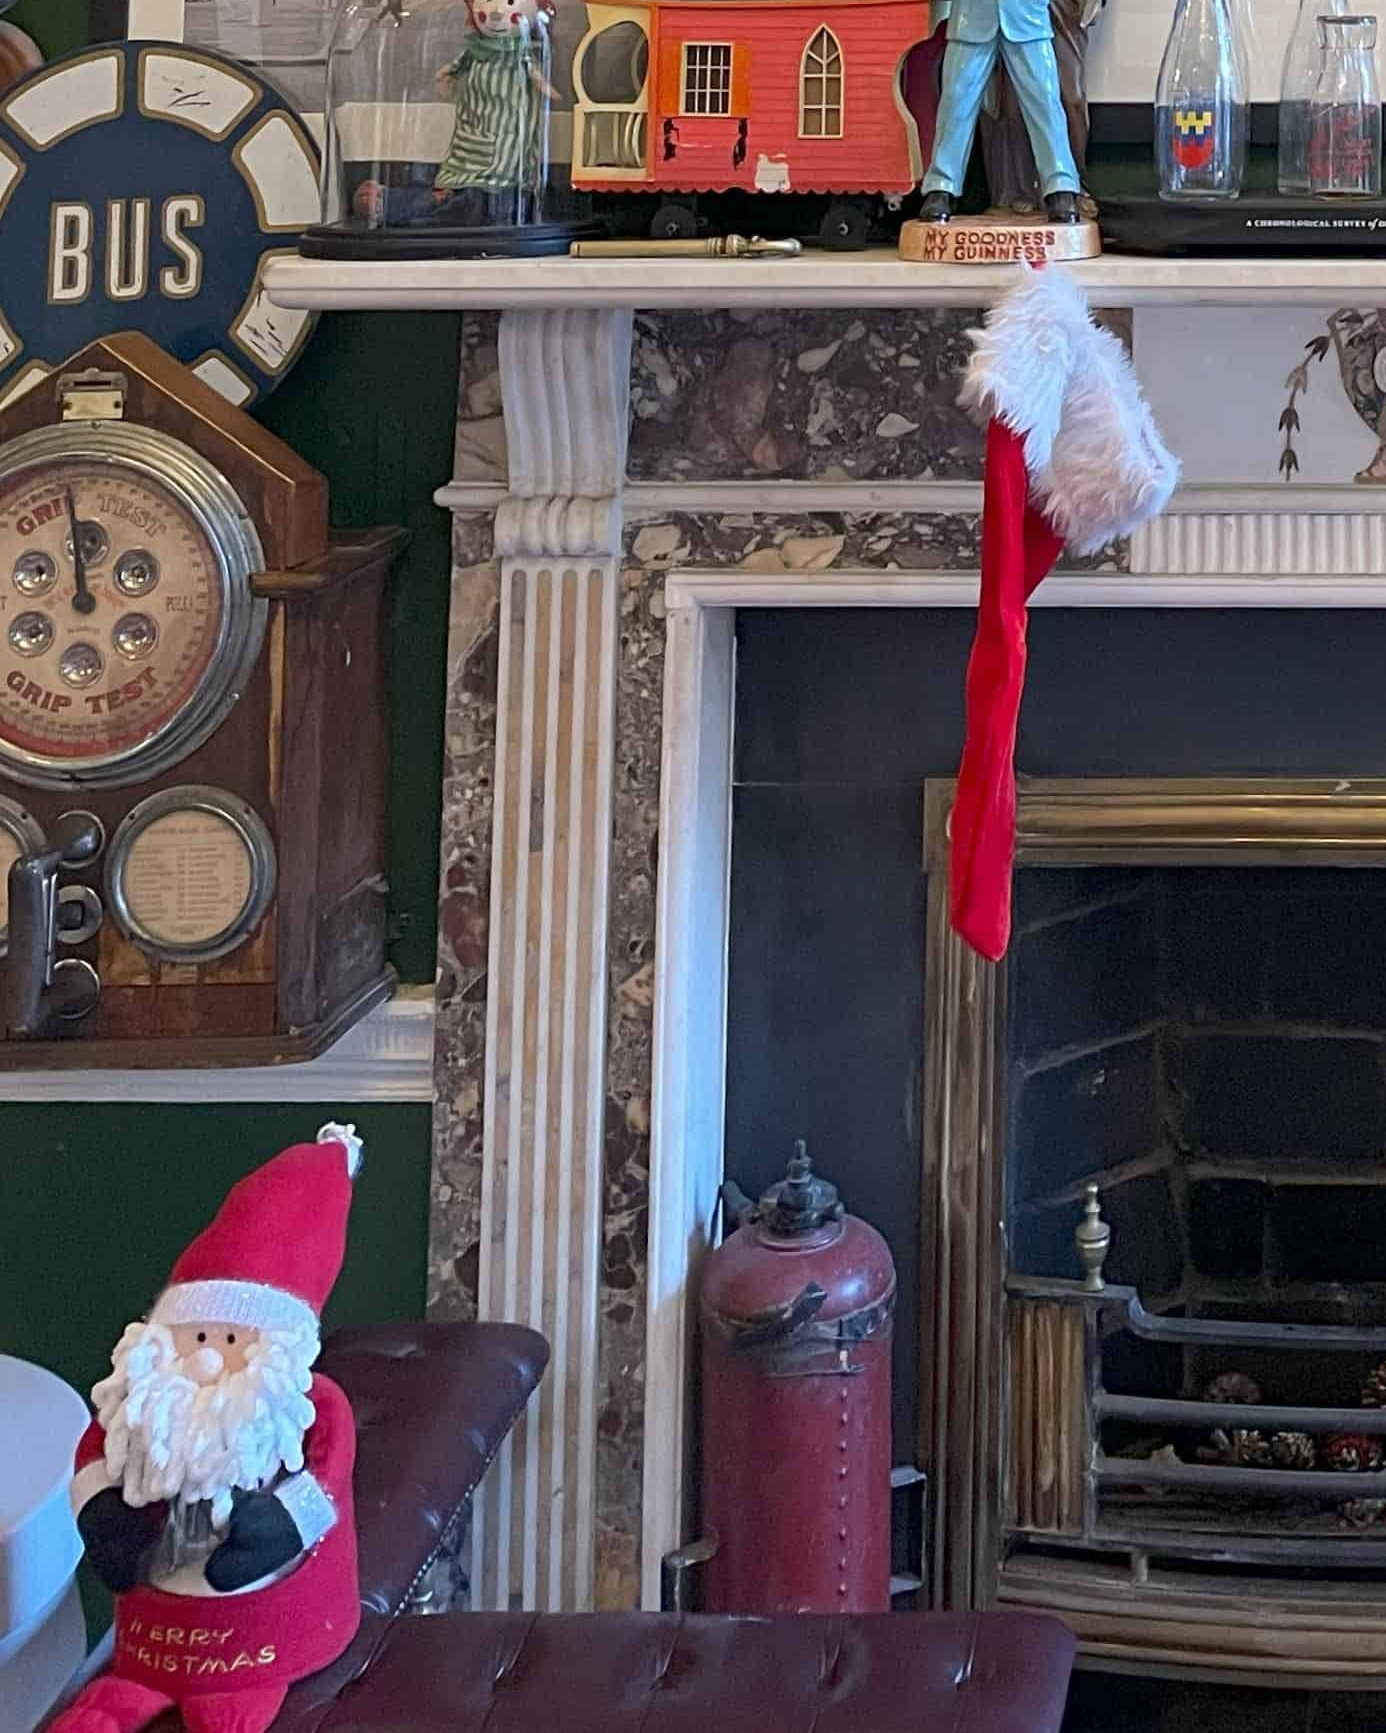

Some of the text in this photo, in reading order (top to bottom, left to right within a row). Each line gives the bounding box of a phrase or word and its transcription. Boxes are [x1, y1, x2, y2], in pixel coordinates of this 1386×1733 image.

[924, 229, 1056, 246] MY GOODNESS
[1246, 219, 1252, 227] A
[1254, 219, 1331, 228] CHRONOLOGICAL
[48, 195, 206, 306] BUS
[923, 246, 1047, 261] MY GUINNESS
[97, 492, 168, 538] TEST
[6, 667, 158, 714] GRIP TEST
